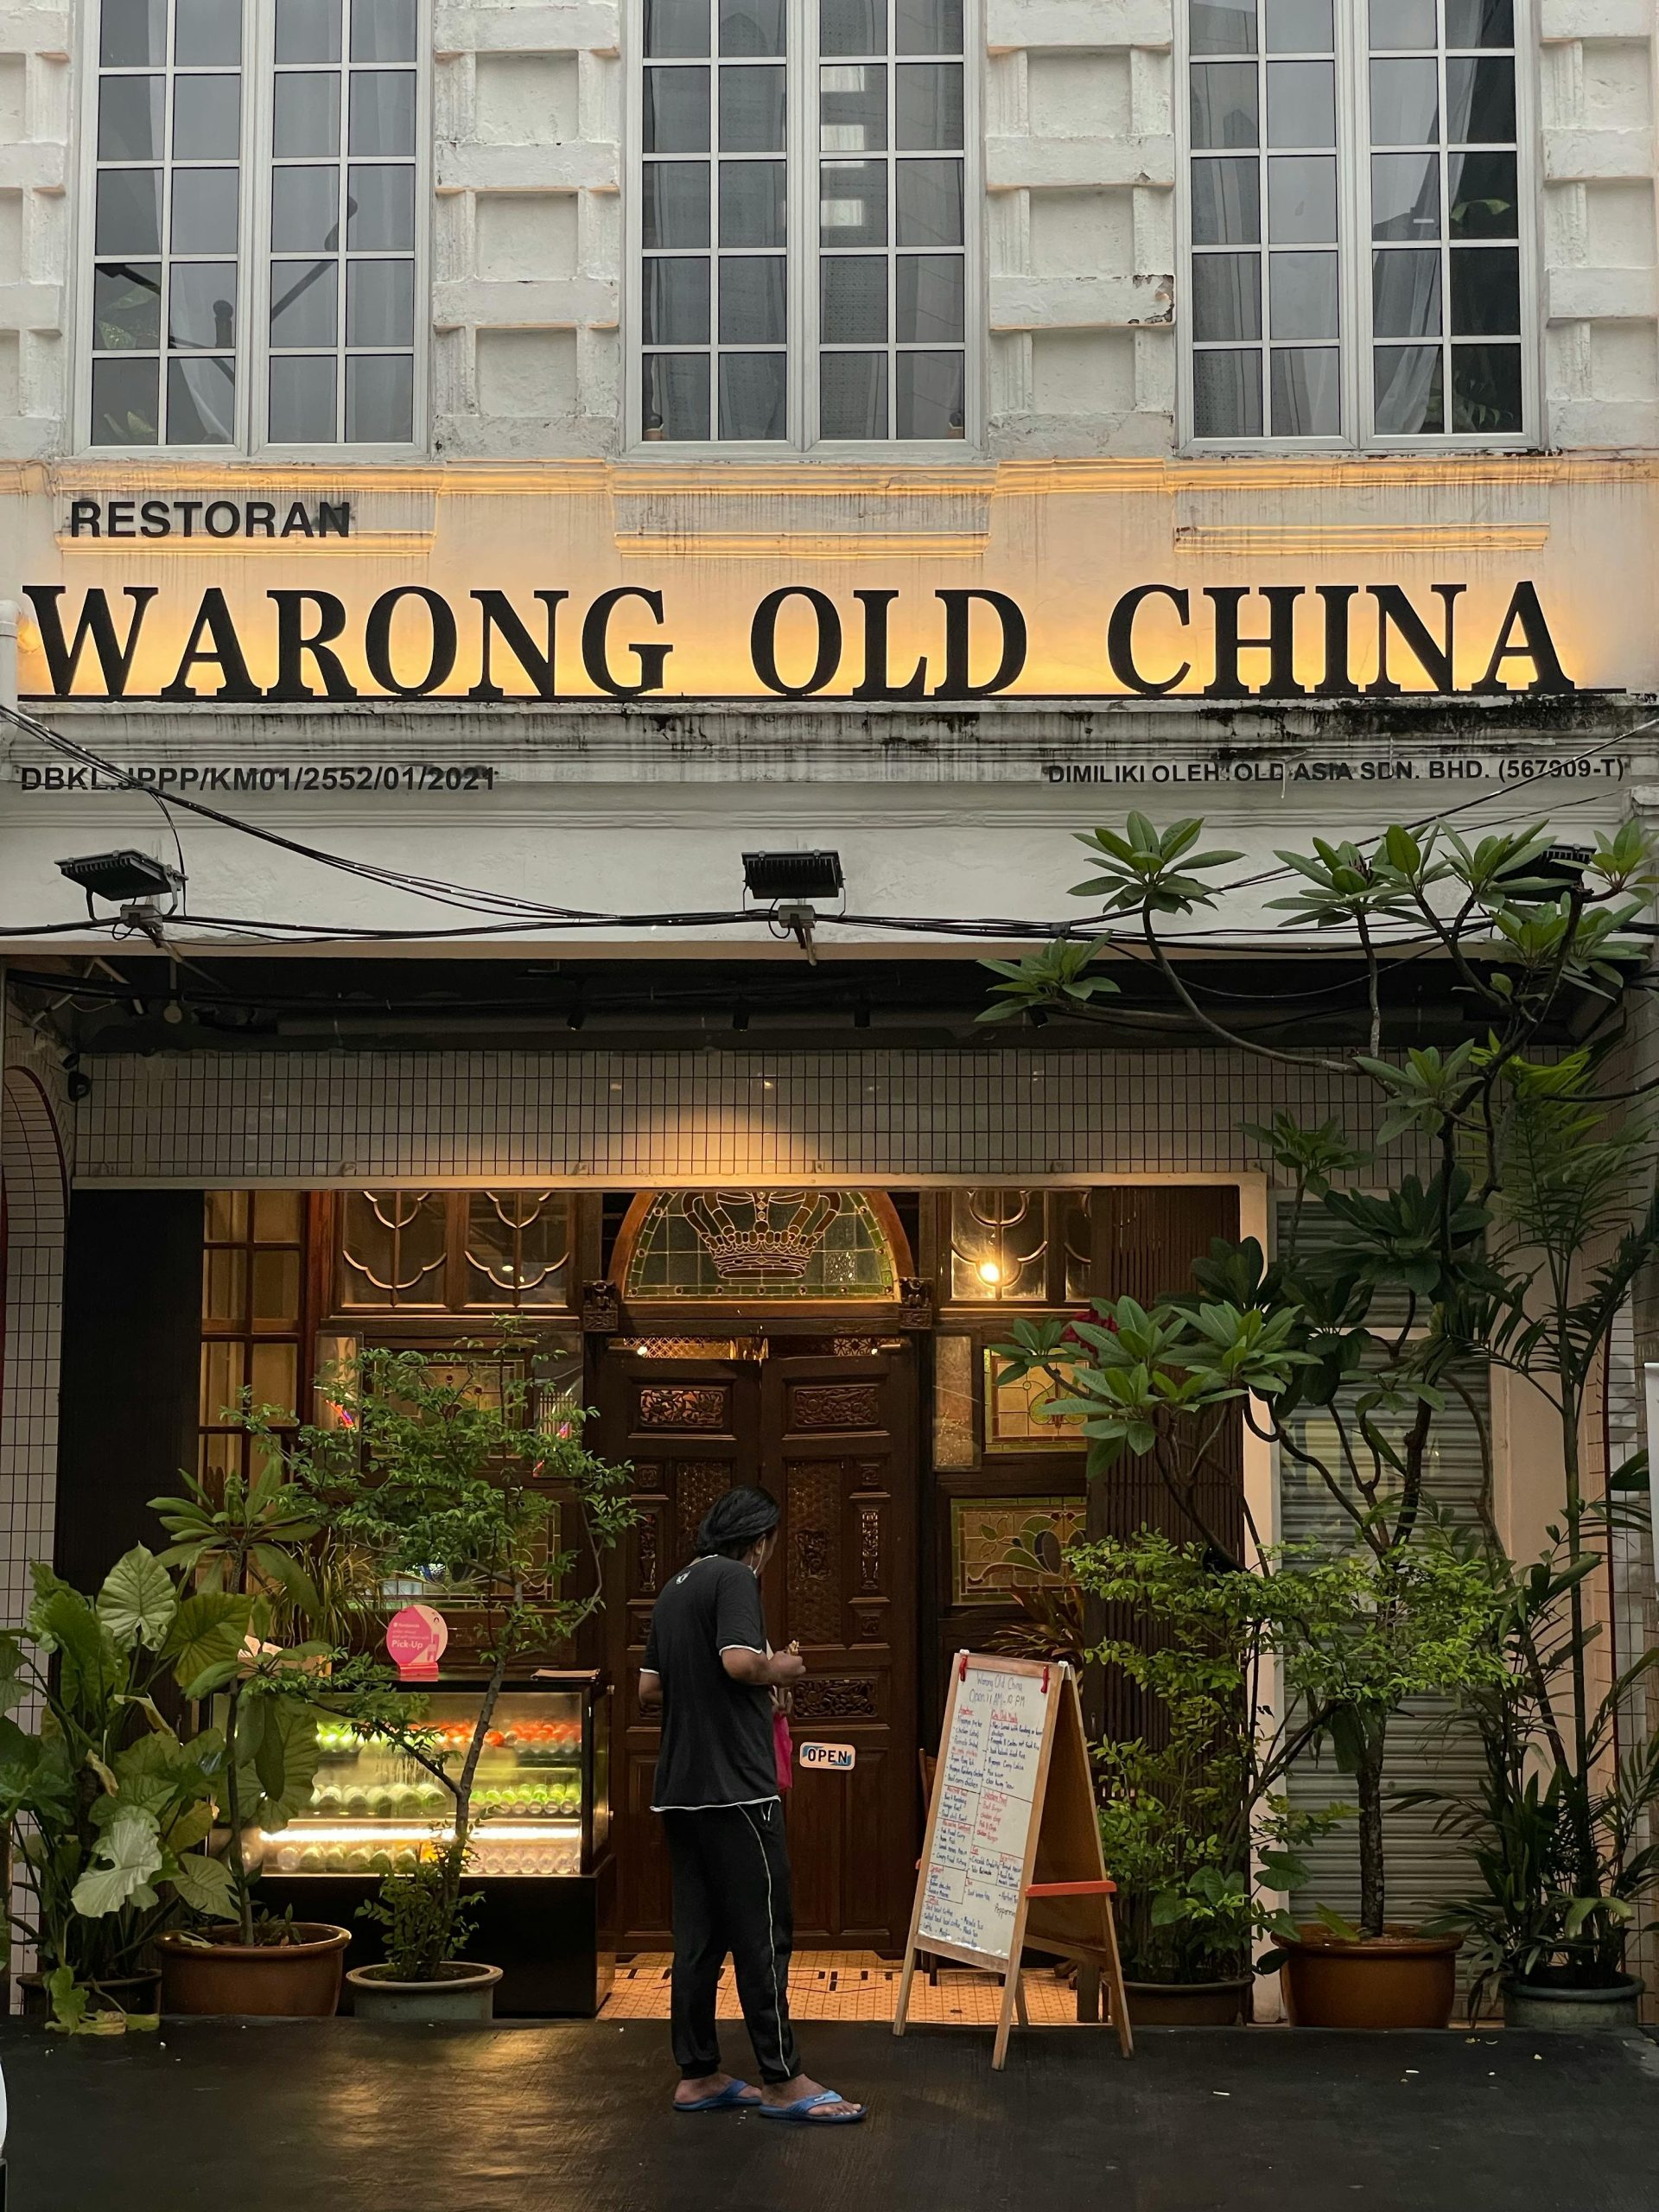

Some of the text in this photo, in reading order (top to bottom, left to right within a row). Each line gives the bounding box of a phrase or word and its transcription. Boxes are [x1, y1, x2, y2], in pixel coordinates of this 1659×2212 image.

[69, 500, 351, 538] RESTORAN
[22, 581, 1577, 697] WARONG OLD CHINA
[1048, 765, 1145, 784] DIMILIKI
[1235, 764, 1284, 781] OLD
[1294, 762, 1352, 781] ASIA
[1429, 760, 1490, 779] BHD.
[391, 1639, 423, 1650] Pick-Up
[808, 1748, 848, 1764] OPEN
